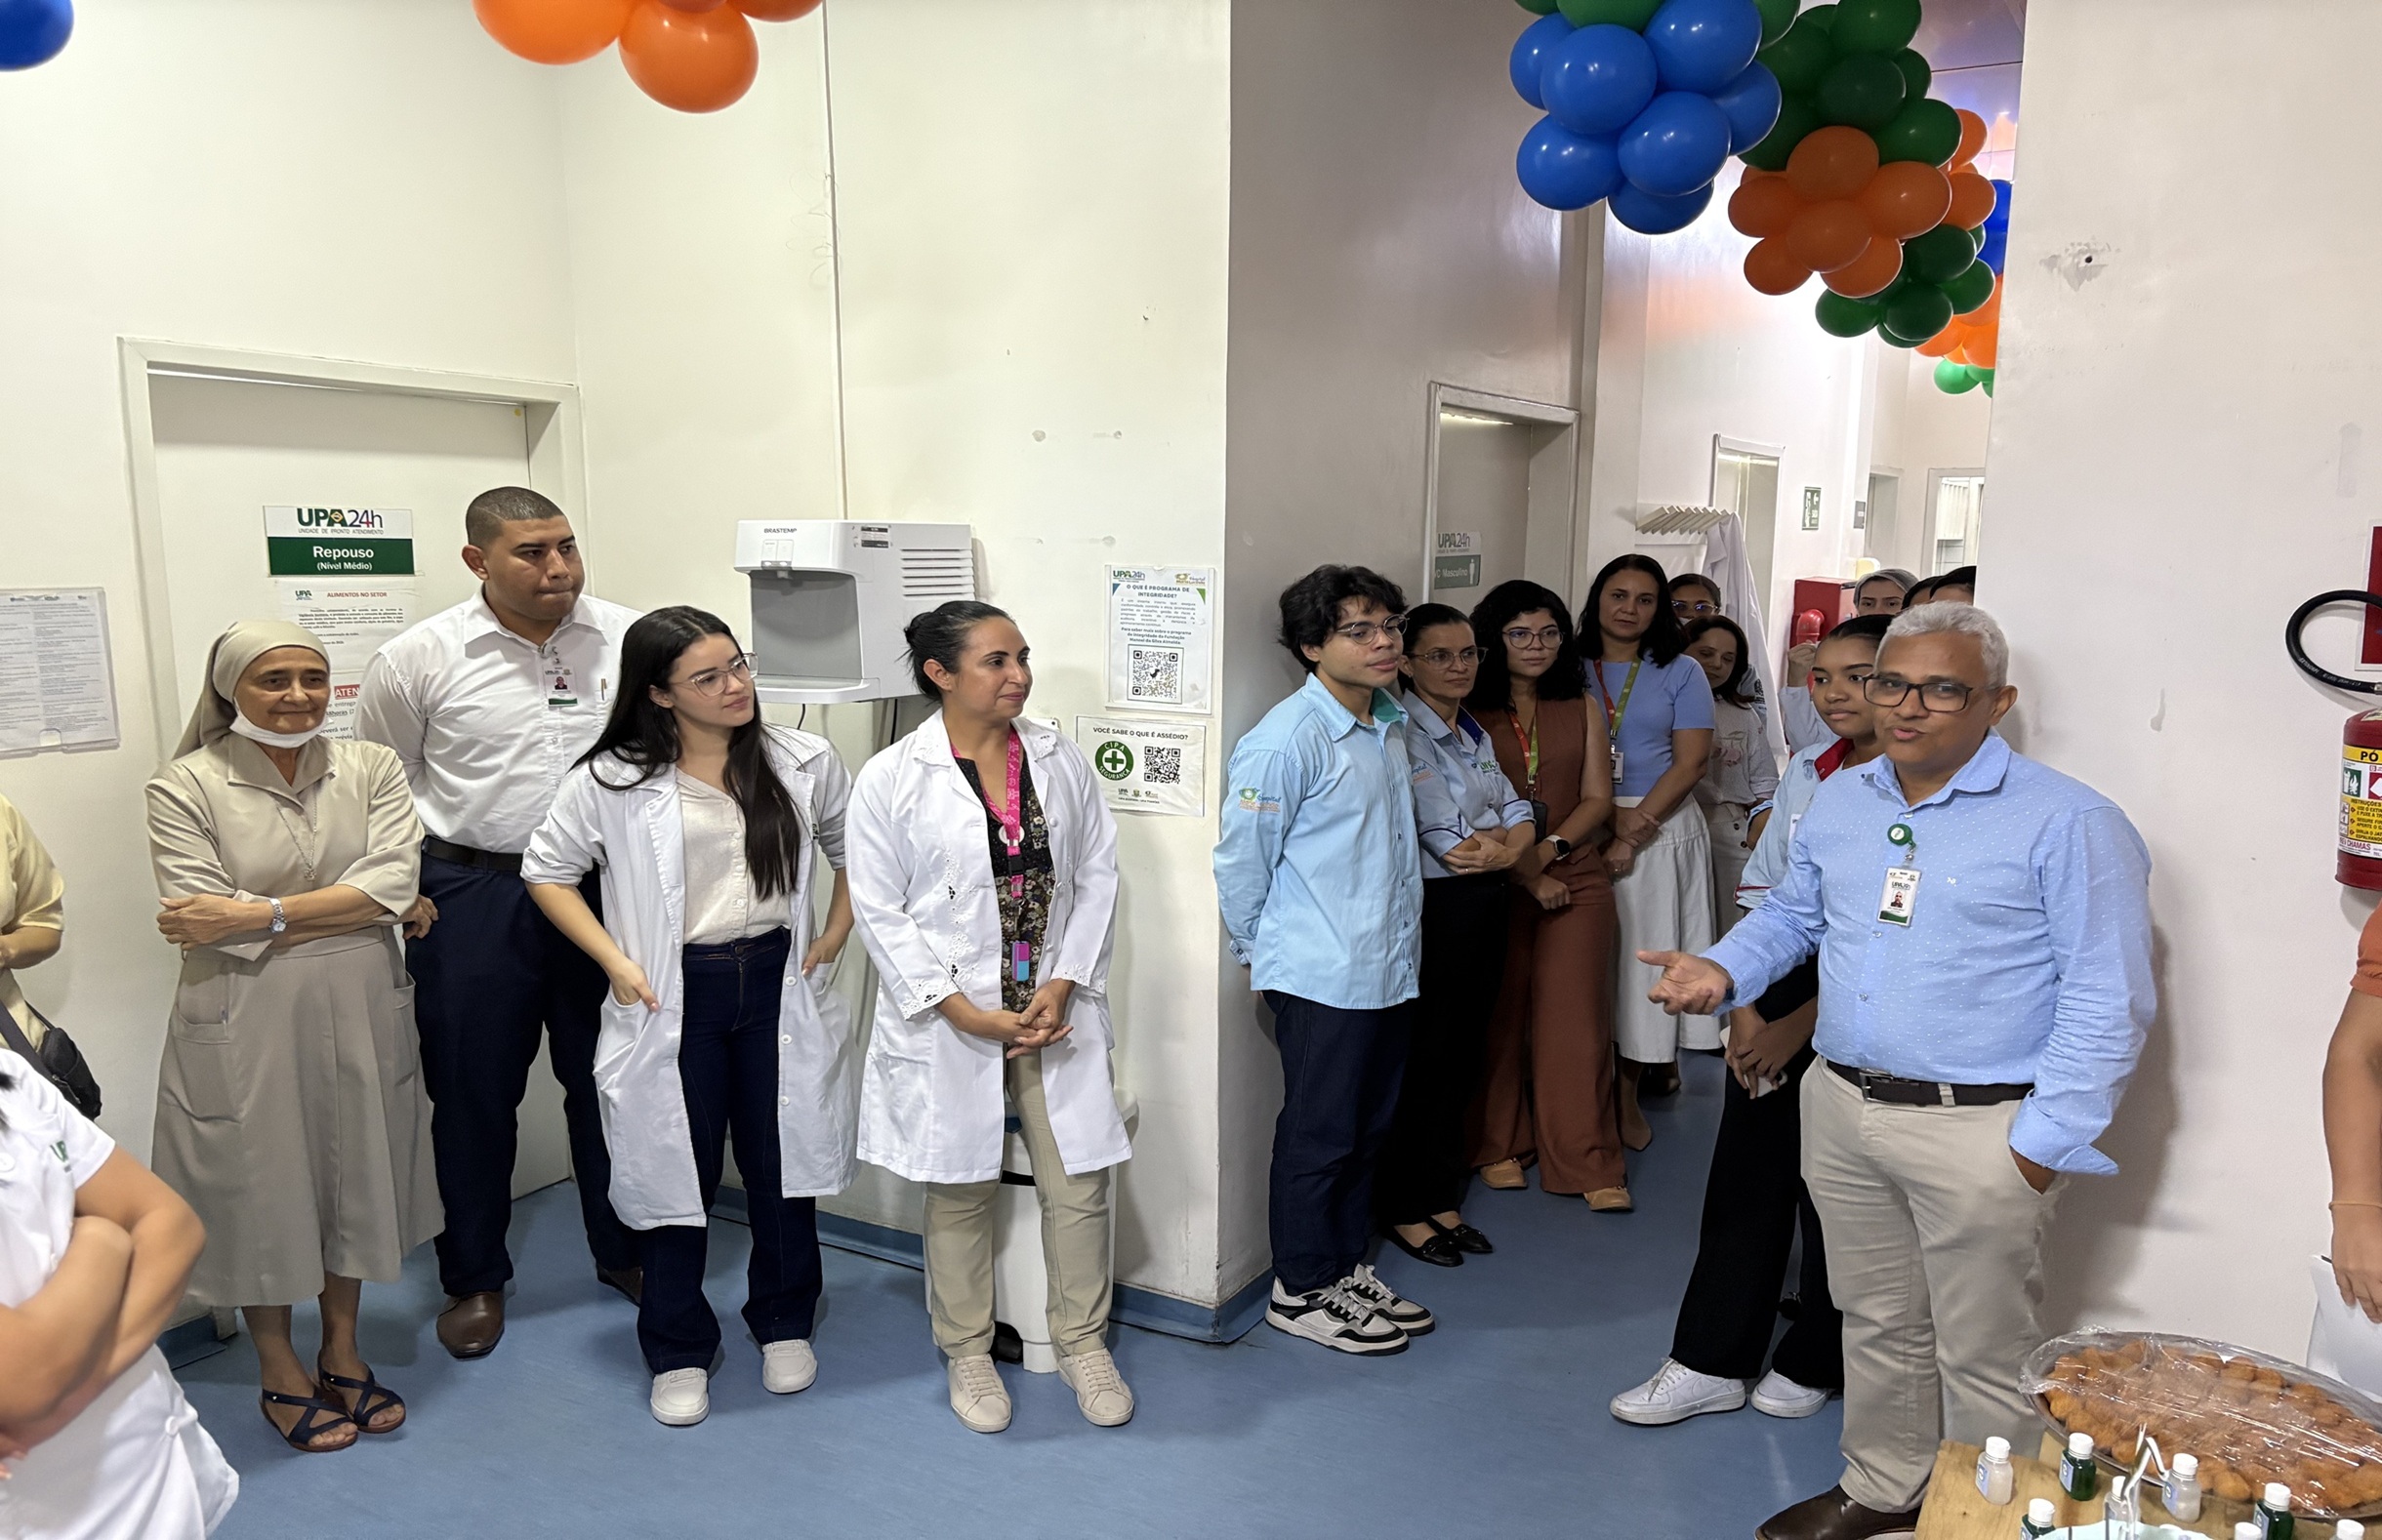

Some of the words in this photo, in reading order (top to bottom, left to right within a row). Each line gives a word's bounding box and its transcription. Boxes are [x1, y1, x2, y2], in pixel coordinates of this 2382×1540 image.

[313, 546, 374, 560] Repouso
[343, 562, 372, 571] Médio)
[1442, 568, 1468, 577] Masculino
[335, 687, 359, 697] ATEN
[1157, 732, 1188, 740] ASSÉDIO?
[1105, 742, 1125, 751] CIPA
[2360, 750, 2379, 762] PÓ
[2351, 799, 2381, 808] INSTRUÇÕES
[2347, 840, 2371, 850] CHAMAS
[49, 1140, 69, 1162] UP
